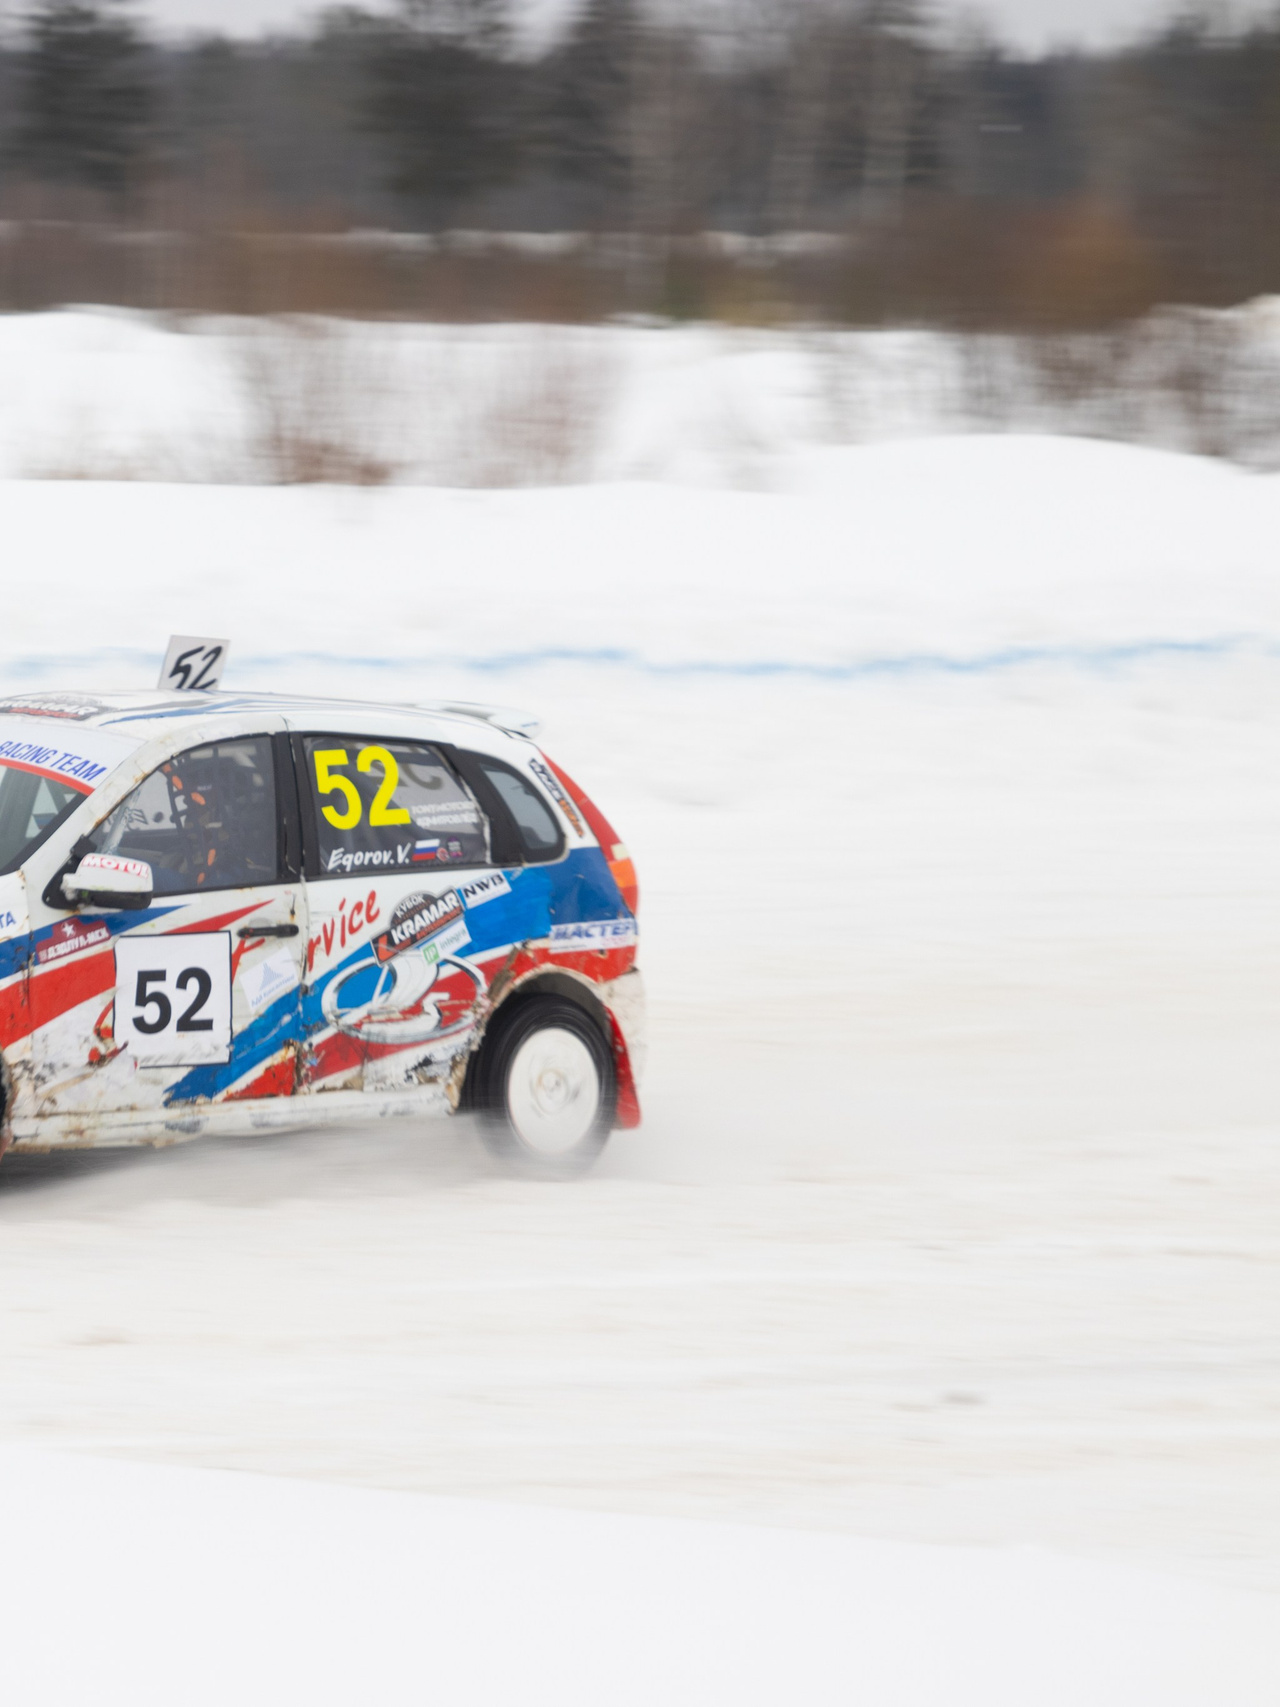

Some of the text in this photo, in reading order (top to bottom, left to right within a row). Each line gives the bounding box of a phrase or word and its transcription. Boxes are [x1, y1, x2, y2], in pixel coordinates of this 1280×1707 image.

[168, 645, 222, 690] 52
[50, 752, 107, 782] TEAM
[313, 745, 412, 830] 52
[81, 855, 150, 880] MOTUL
[391, 891, 460, 945] KRAMAR
[132, 966, 214, 1035] 52
